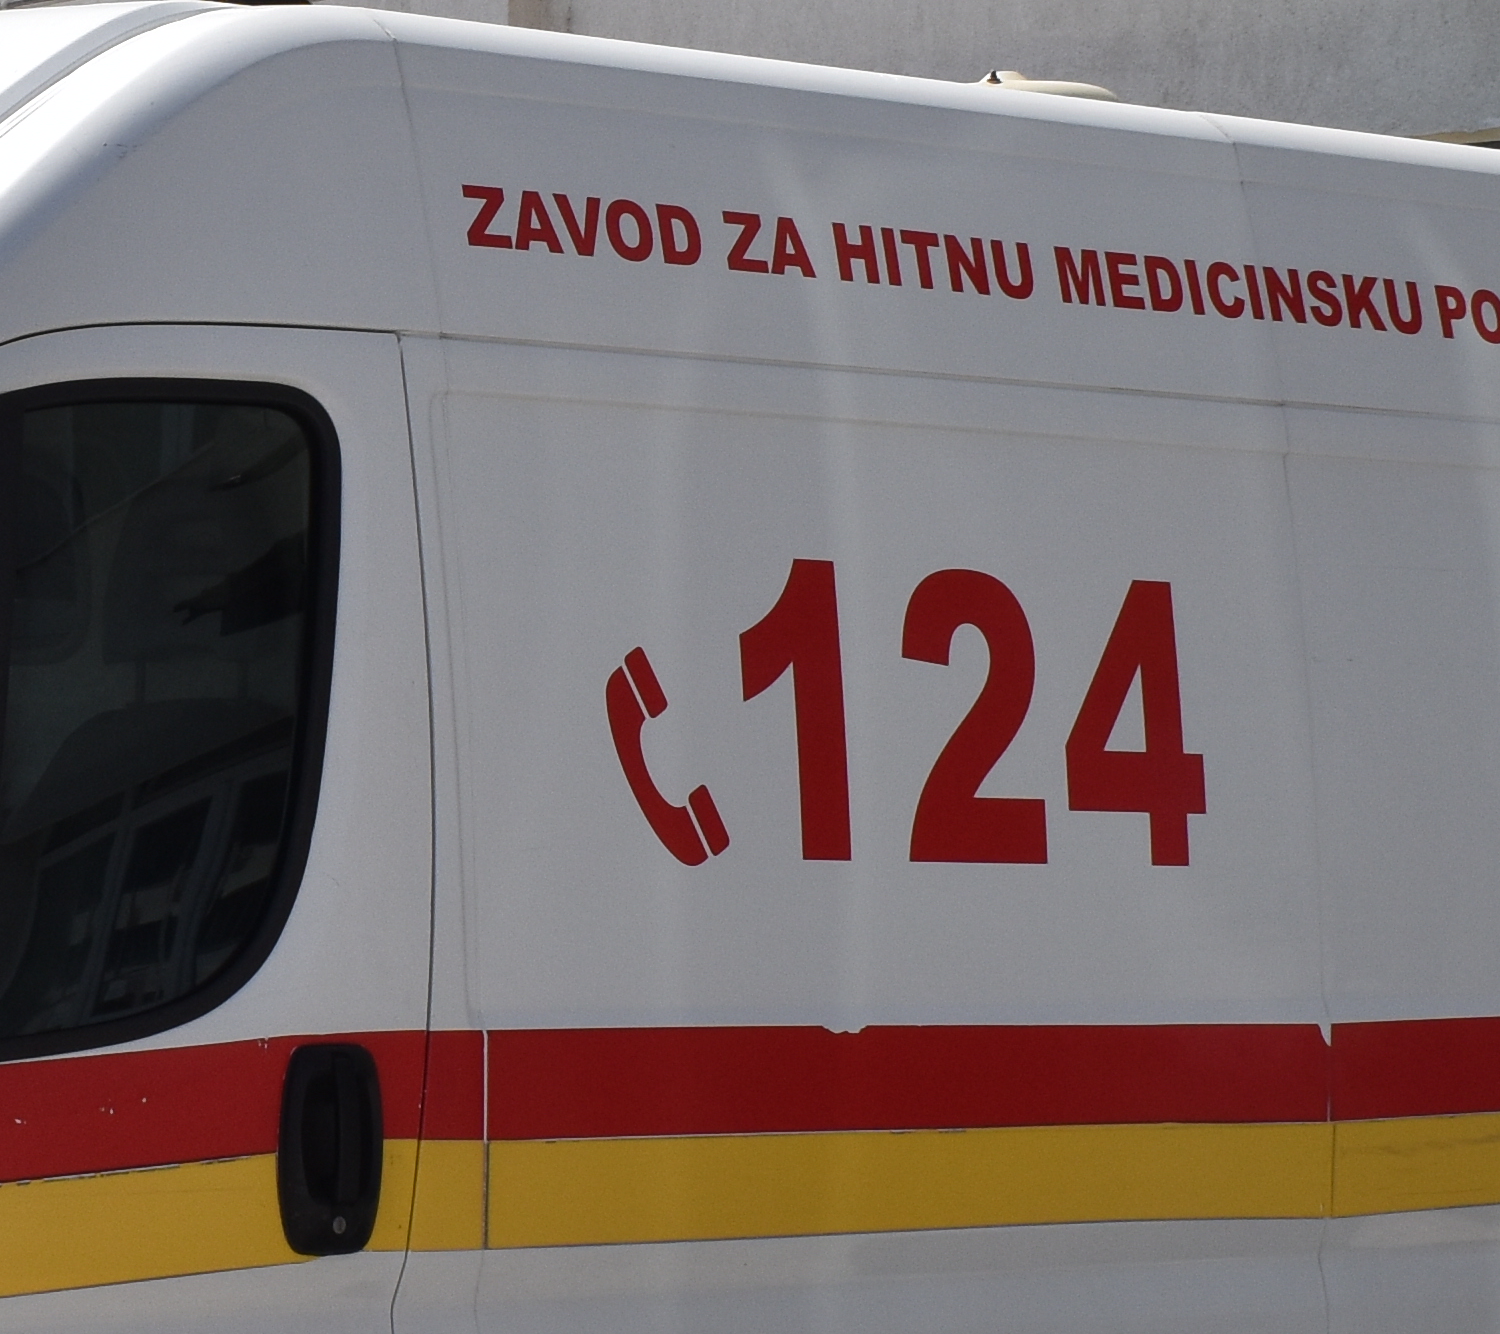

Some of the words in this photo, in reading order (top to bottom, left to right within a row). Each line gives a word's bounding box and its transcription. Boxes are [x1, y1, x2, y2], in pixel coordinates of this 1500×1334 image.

[461, 184, 702, 266] ZAVOD
[722, 211, 816, 279] ZA
[832, 222, 1034, 300] HITNU
[1054, 246, 1423, 335] MEDICINSKU
[740, 558, 1207, 867] 124
